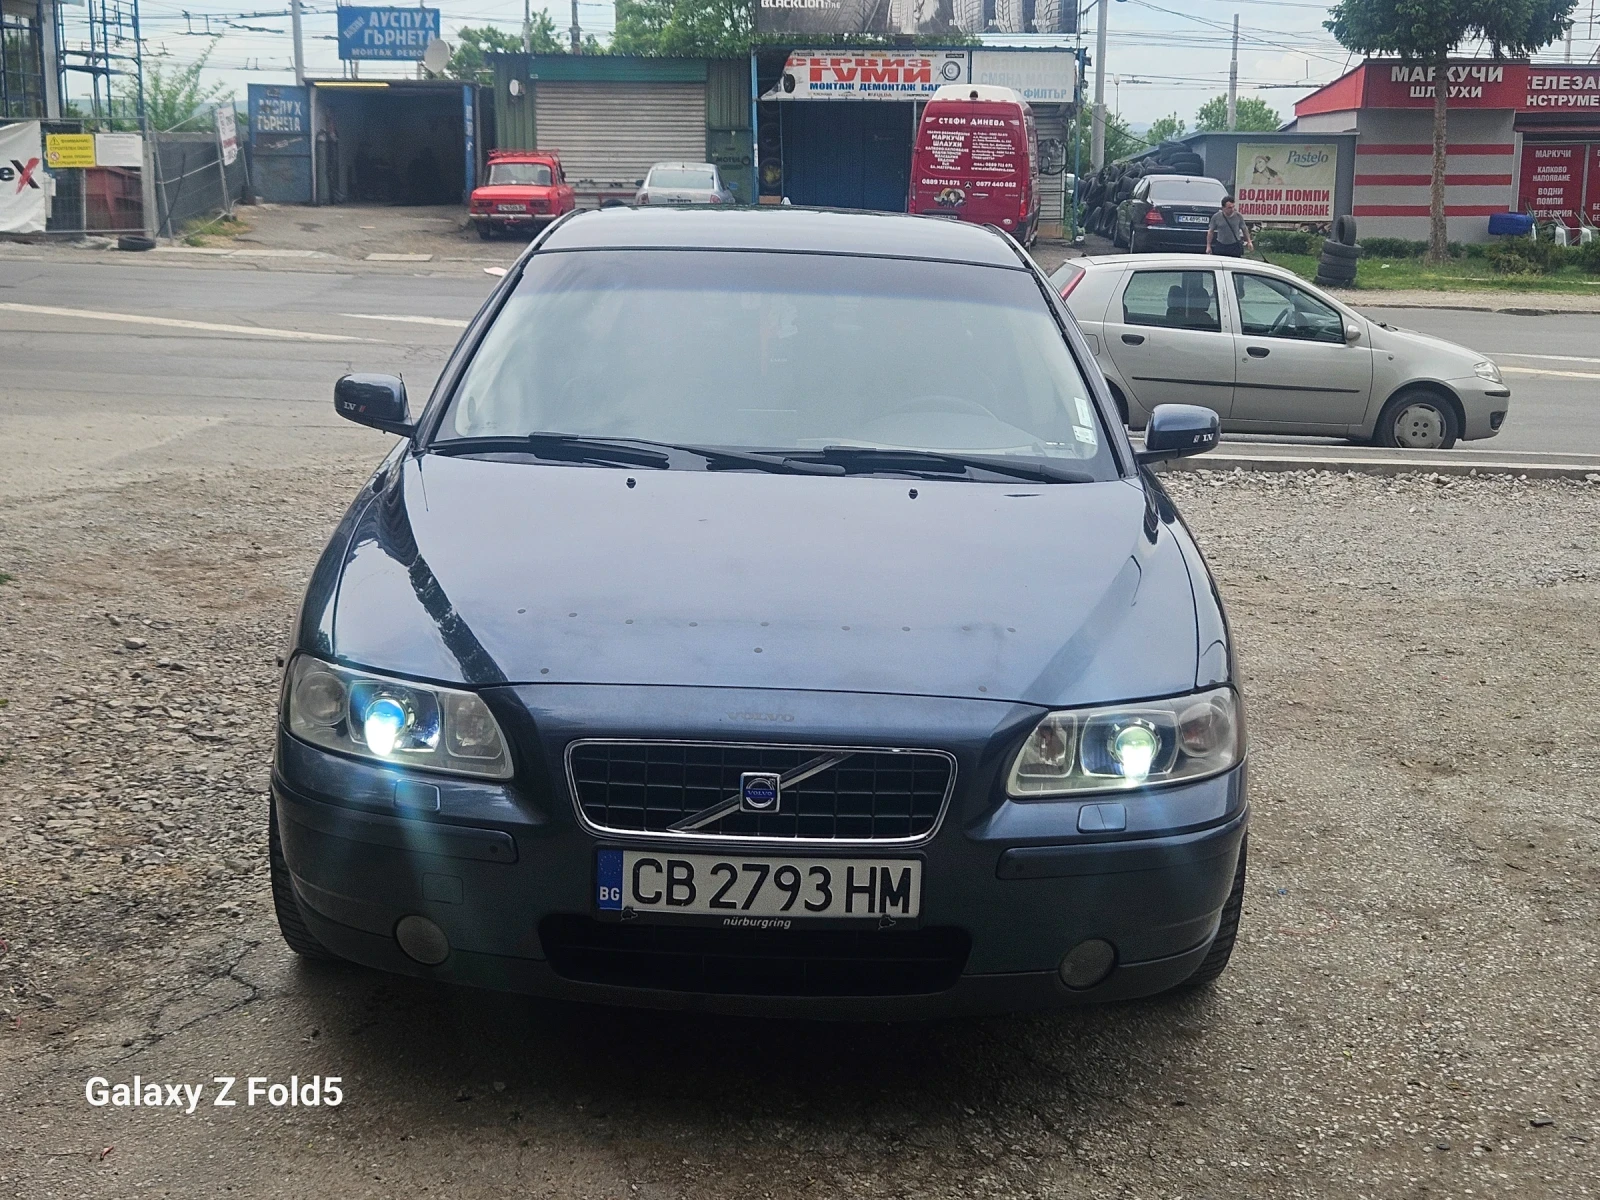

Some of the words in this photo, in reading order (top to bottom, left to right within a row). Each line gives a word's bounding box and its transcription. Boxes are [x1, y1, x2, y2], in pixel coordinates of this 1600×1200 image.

[369, 11, 435, 28] АУСПУХ
[351, 48, 392, 57] МОНТАЖ
[397, 49, 427, 57] РЕМО
[785, 57, 931, 68] СЕРВИЗ
[809, 67, 931, 83] ГУМИ
[809, 82, 855, 91] МОНТАЖ
[859, 82, 916, 92] ДЕМОНТАЖ
[1023, 88, 1067, 99] ФИЛТЪР
[938, 116, 967, 125] СТЕФИ
[969, 118, 1005, 127] ДИНЕВА
[931, 134, 965, 142] МАРКУЧИ
[932, 140, 963, 148] ШЛАУХИ
[1286, 150, 1329, 164] Pastelo
[1535, 149, 1572, 158] МАРКУЧИ
[1532, 174, 1571, 182] НАПОЯВАНЕ
[1238, 188, 1283, 203] ВОДНИ
[1285, 189, 1330, 202] ПОМПИ
[1537, 187, 1564, 196] ВОДНИ
[1536, 197, 1564, 205] ПОМПИ
[1238, 203, 1278, 215] КАПКОВО
[1279, 204, 1330, 216] НАПОЯВАНЕ
[1202, 433, 1214, 442] LV
[726, 711, 795, 723] VOLVO
[600, 886, 620, 901] BG
[632, 857, 697, 907] CB
[709, 862, 833, 913] 2793
[845, 866, 912, 914] HM
[723, 916, 792, 931] nürburgring
